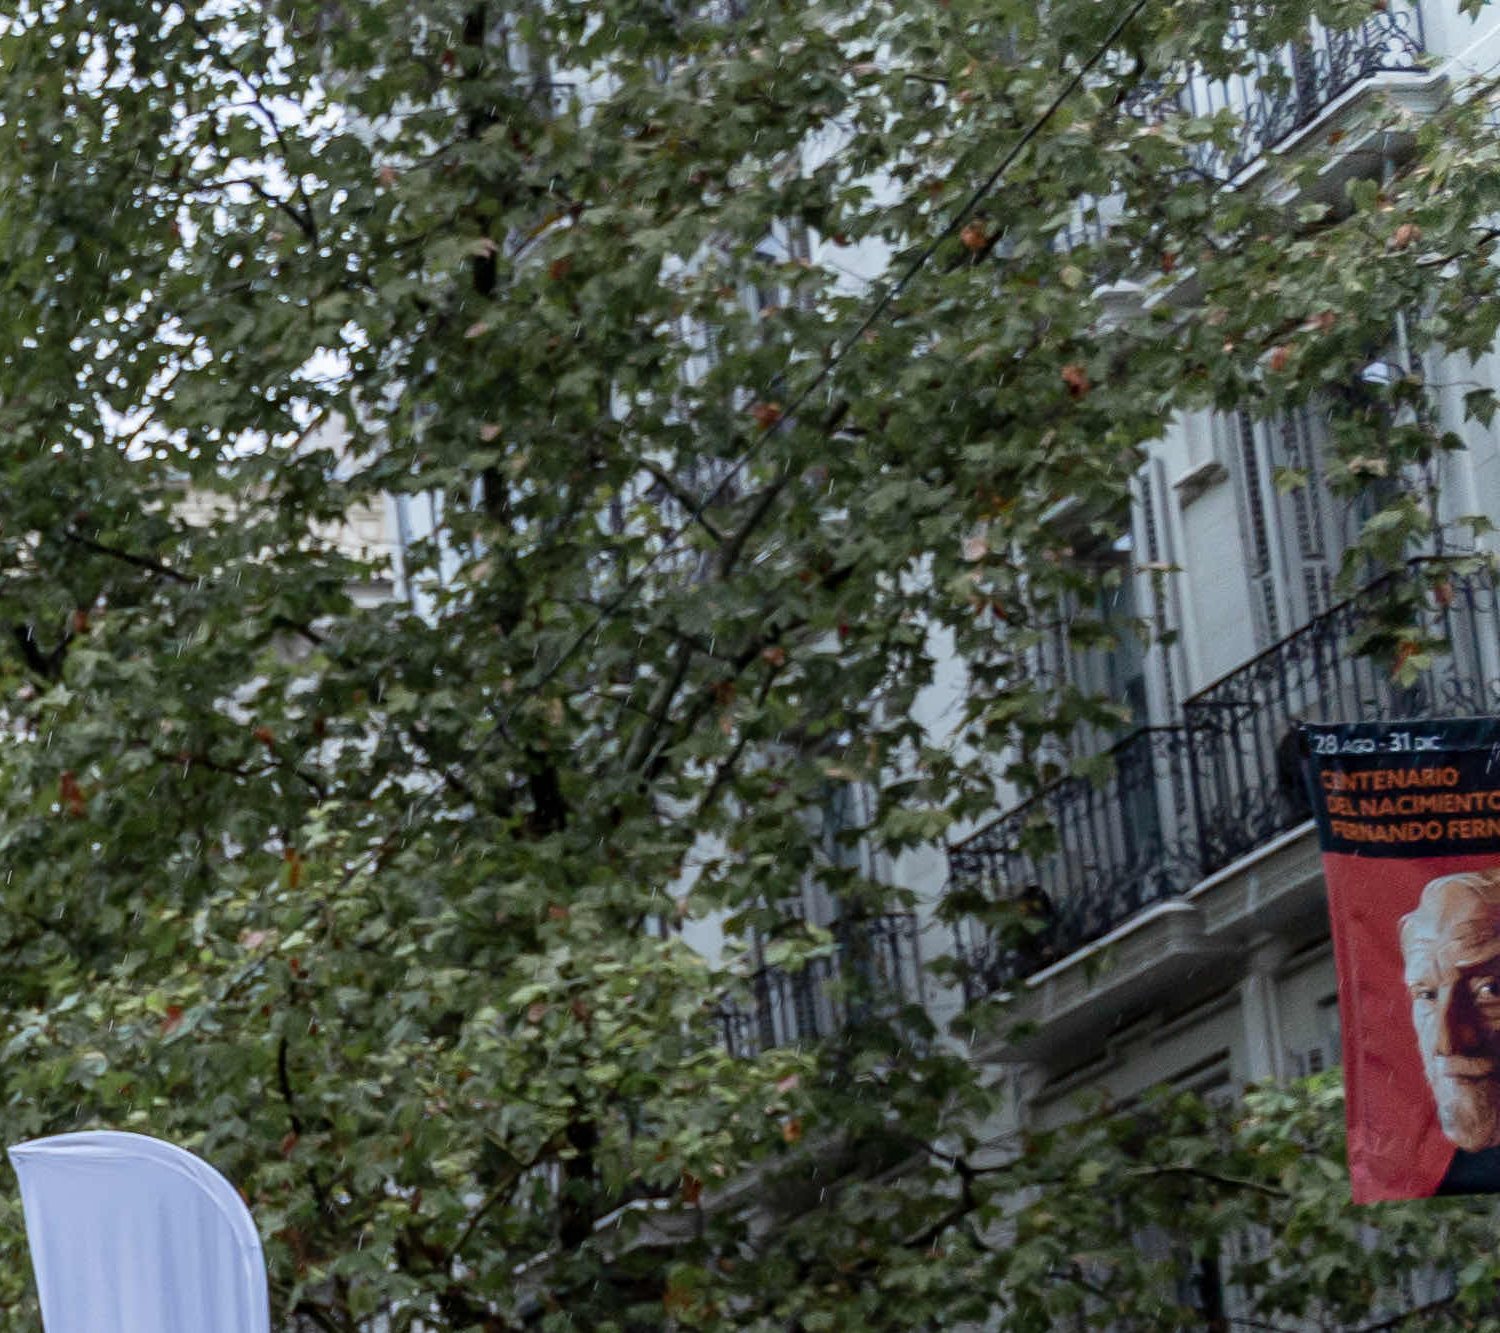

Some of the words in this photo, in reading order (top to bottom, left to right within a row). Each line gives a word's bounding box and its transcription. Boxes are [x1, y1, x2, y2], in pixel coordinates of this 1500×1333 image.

[1314, 733, 1339, 755] 28
[1389, 732, 1411, 752] 31
[1320, 767, 1461, 791] CENTENARIO
[1326, 796, 1358, 816] DEL
[1331, 820, 1444, 843] FERNANDO
